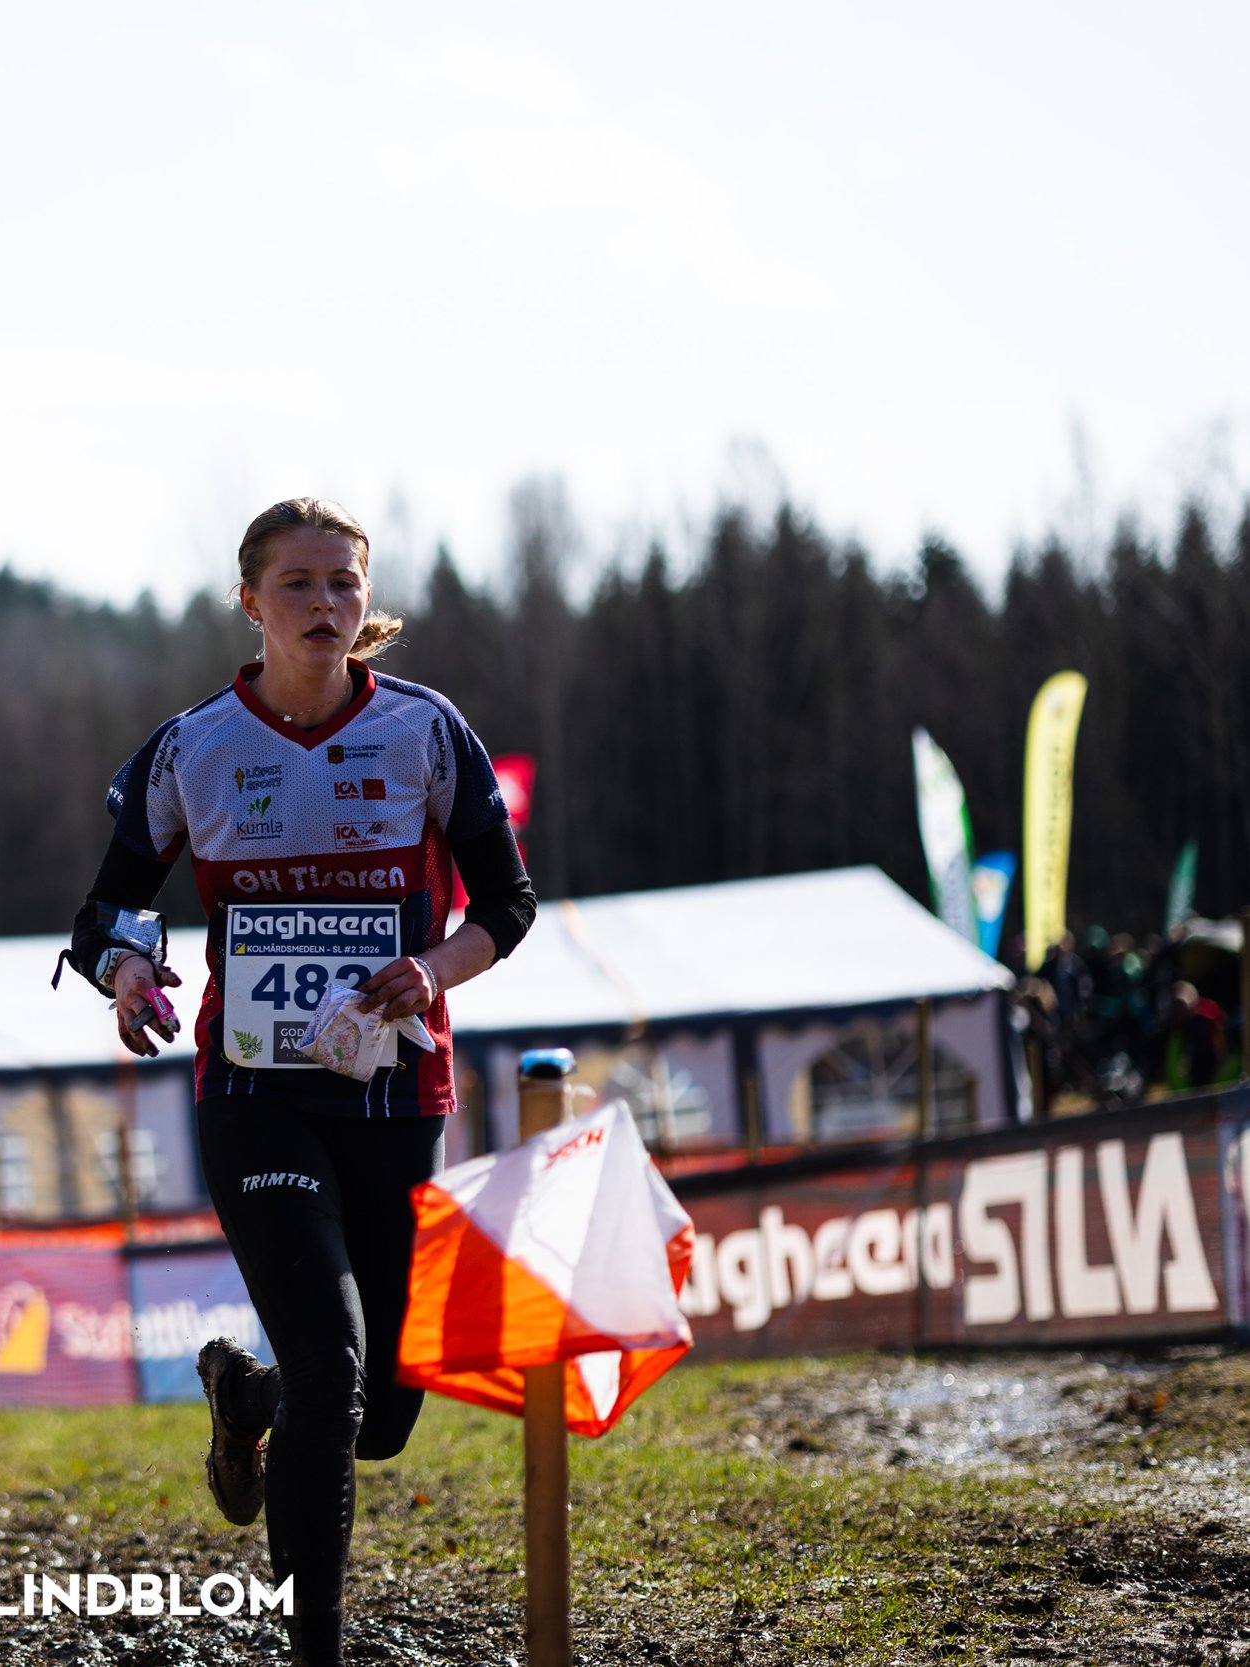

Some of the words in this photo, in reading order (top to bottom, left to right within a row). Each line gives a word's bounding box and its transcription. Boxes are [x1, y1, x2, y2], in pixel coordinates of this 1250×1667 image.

[334, 781, 359, 795] ICA
[236, 819, 283, 835] Kumla
[336, 825, 360, 839] ICA
[233, 870, 283, 893] OK
[288, 865, 405, 891] Tisaren
[233, 911, 393, 939] bagheera
[247, 943, 325, 954] KOLMÅRDSMEDELN
[333, 946, 342, 954] SL
[344, 946, 356, 954] #2
[359, 946, 380, 954] 2026
[242, 1172, 321, 1192] TRIMTEX
[959, 1132, 1219, 1326] SILVA
[681, 1204, 954, 1331] agheera
